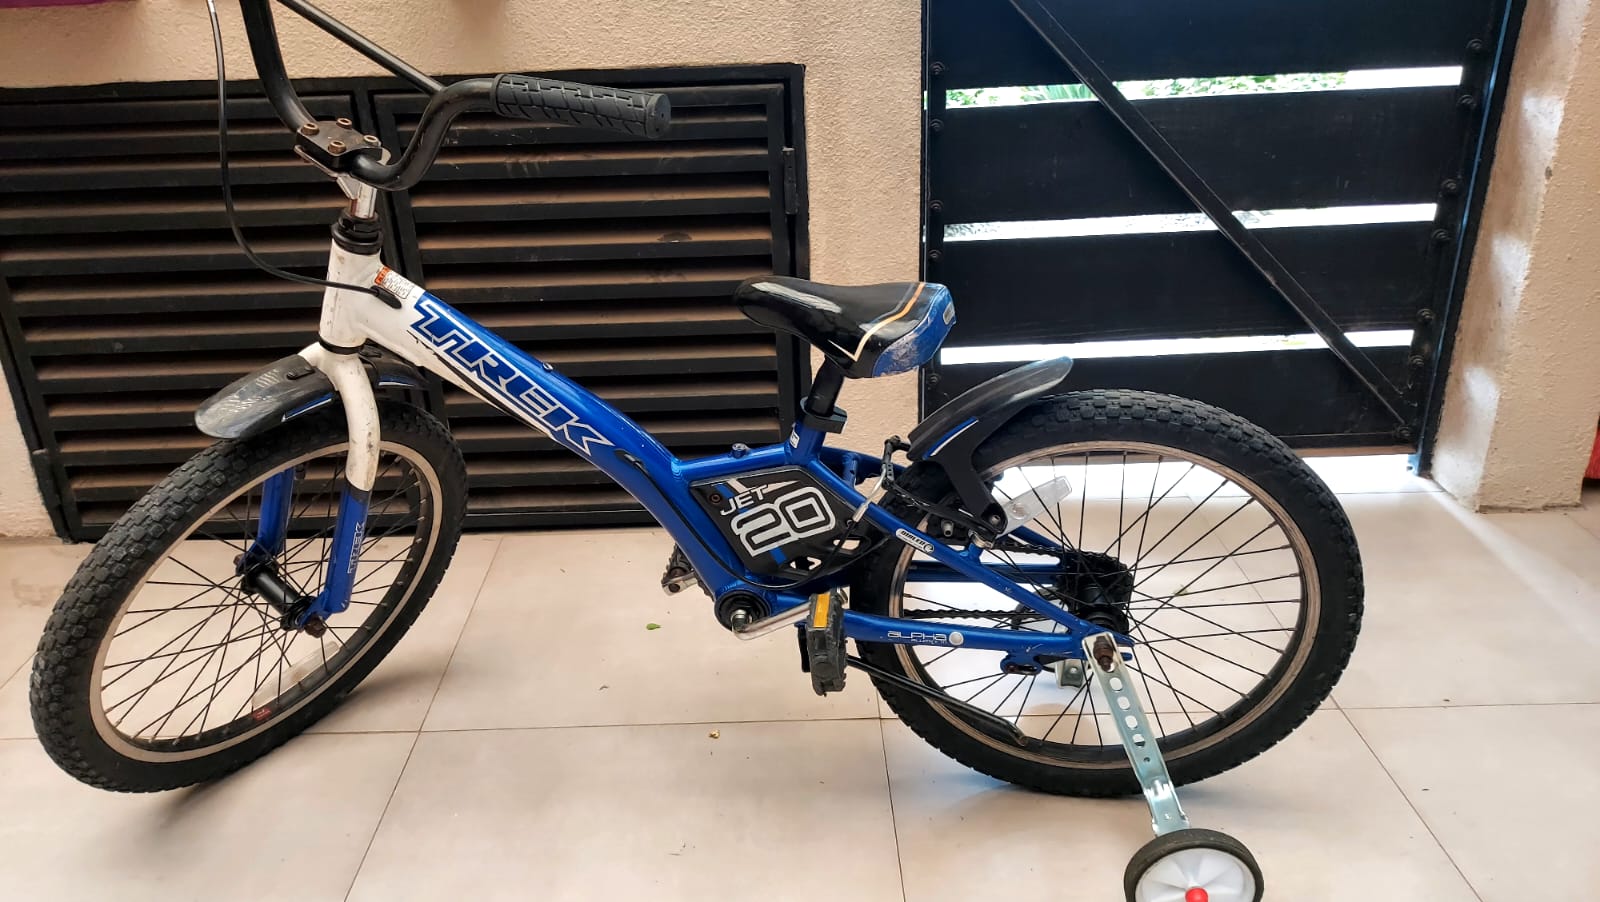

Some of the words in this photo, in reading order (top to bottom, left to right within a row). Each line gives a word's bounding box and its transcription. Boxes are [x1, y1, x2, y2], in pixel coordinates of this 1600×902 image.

[410, 299, 615, 456] TREK
[720, 484, 769, 516] JET
[730, 486, 836, 557] 20
[347, 521, 365, 574] TREK
